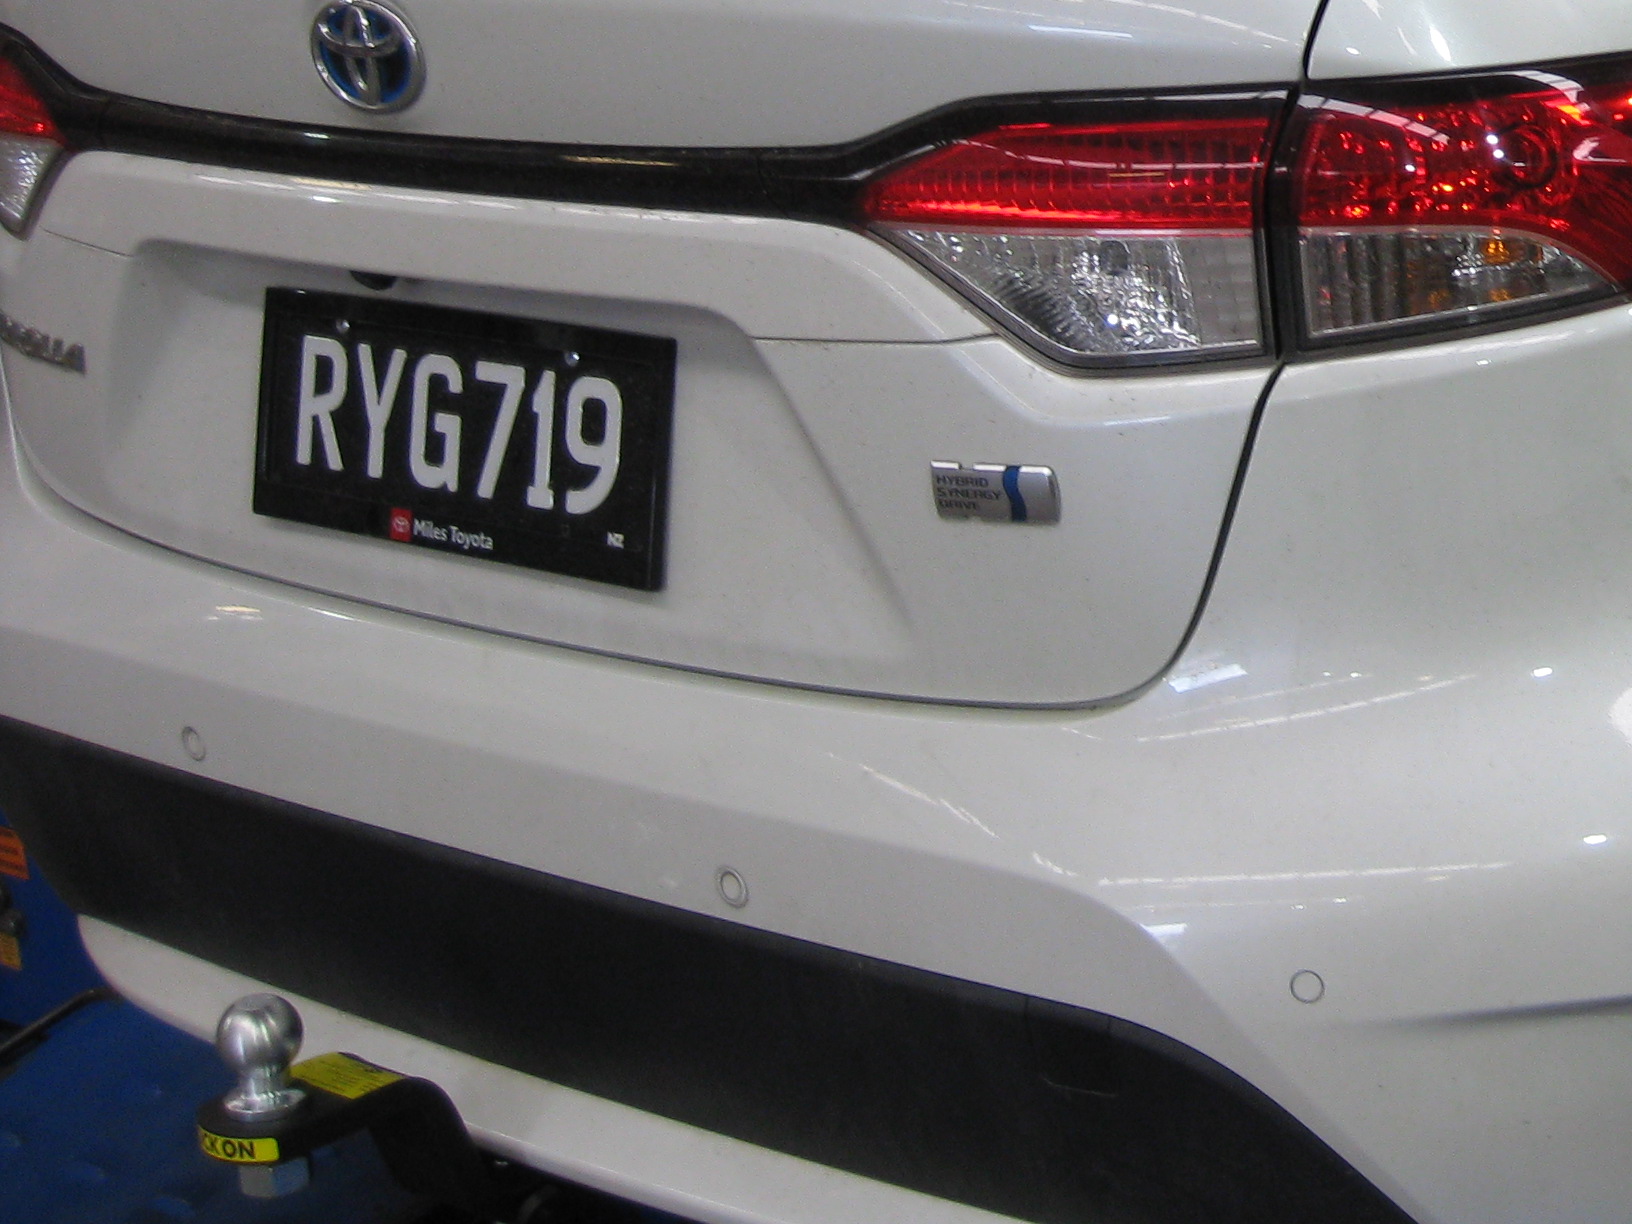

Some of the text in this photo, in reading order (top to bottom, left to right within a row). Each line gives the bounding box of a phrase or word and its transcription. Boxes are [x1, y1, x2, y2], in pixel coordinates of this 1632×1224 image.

[296, 334, 624, 515] RYG719
[936, 475, 988, 487] HYBRID
[936, 487, 1003, 500] SYNERGY
[412, 517, 494, 551] Miles Toyota
[606, 531, 625, 549] NZ
